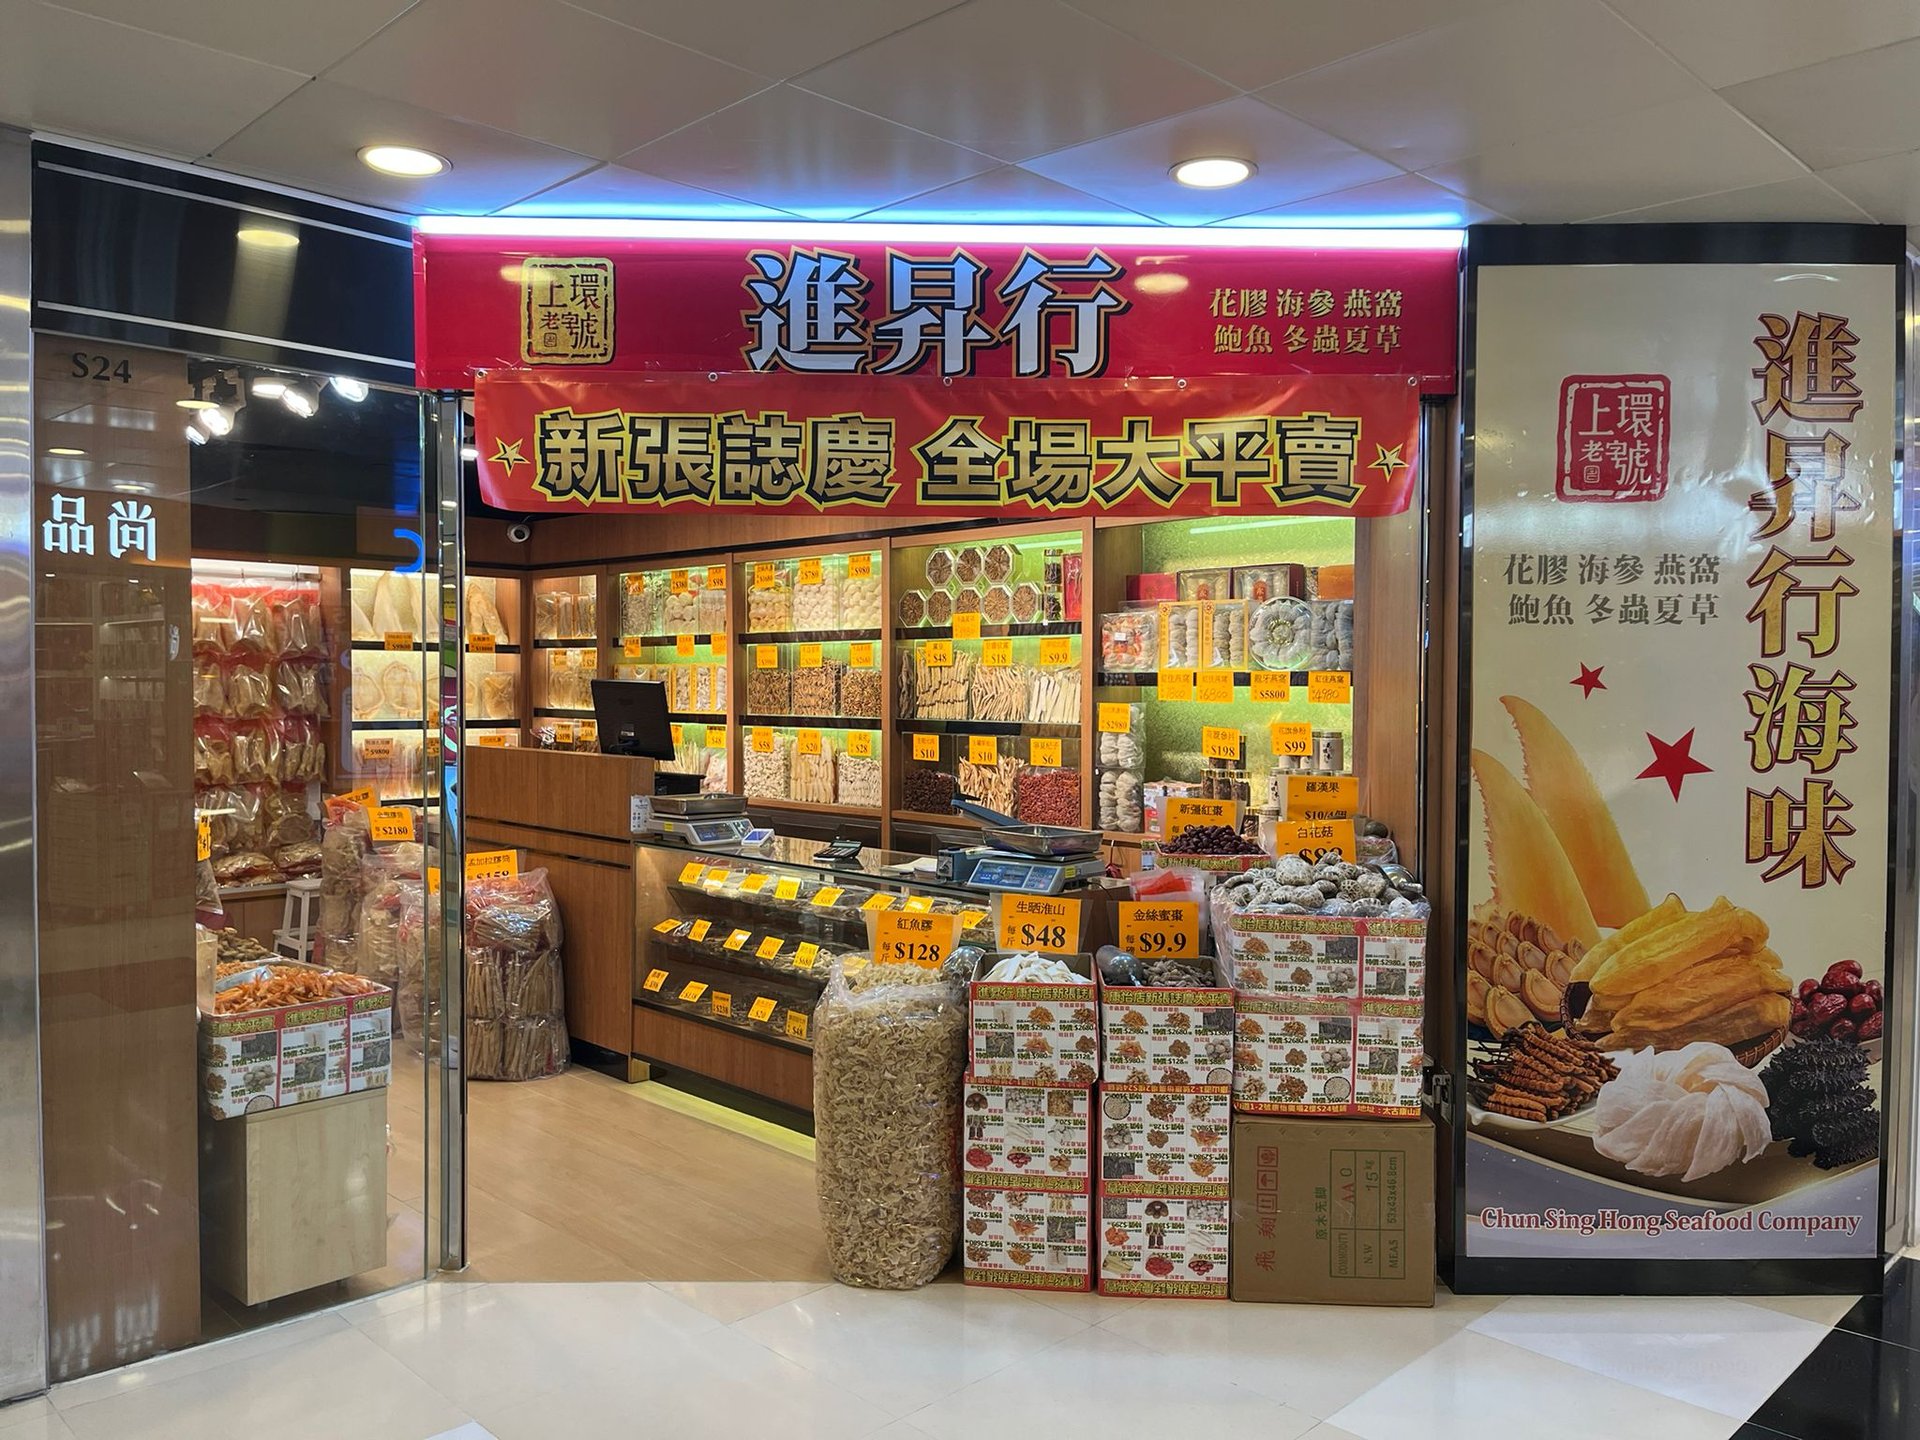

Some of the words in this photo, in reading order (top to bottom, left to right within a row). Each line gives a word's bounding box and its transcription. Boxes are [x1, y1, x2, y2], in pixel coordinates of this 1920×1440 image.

[538, 273, 601, 310] 上環
[743, 247, 1129, 377] 進昇行
[1209, 288, 1267, 319] 花膠
[1277, 288, 1334, 319] 海參
[1343, 289, 1403, 319] 燕窩
[1214, 325, 1273, 354] 鮑魚
[1283, 324, 1402, 355] 冬蟲夏草
[71, 352, 132, 383] S24
[1578, 393, 1654, 438] 上環
[532, 406, 901, 511] 新張誌慶
[910, 412, 1366, 512] 全場大平賣
[1580, 439, 1653, 484] 老字號
[1503, 552, 1568, 586] 花膠
[1578, 552, 1645, 586] 海參
[1654, 552, 1721, 586] 燕窩
[1507, 592, 1574, 626] 鮑魚
[1585, 592, 1720, 626] 冬蟲夏草
[1743, 311, 1864, 889] 進昇行海味
[932, 653, 947, 663] $48
[991, 655, 1007, 664] $18
[1048, 653, 1068, 663] $9.9
[1259, 690, 1285, 699] $5800
[920, 748, 935, 759] $10
[978, 752, 993, 763] $10
[1211, 745, 1235, 757] $198
[1284, 741, 1306, 753] $99
[1042, 754, 1054, 765] $6
[1305, 781, 1340, 793] 羅漢果
[382, 826, 408, 836] $2180
[1297, 825, 1334, 839] 白花菇
[896, 917, 933, 932] 紅魚膠
[1133, 909, 1184, 922] 金絲蜜棗
[1021, 923, 1066, 948] $48
[1139, 932, 1187, 953] $9.9
[894, 942, 940, 962] $128
[1386, 1156, 1399, 1224] 53x43x46.8cm
[1480, 1208, 1540, 1230] Chun
[1544, 1209, 1595, 1236] Sing
[1599, 1209, 1661, 1237] Hong
[1664, 1210, 1752, 1232] Seafood
[1758, 1211, 1863, 1237] Company
[1337, 1232, 1349, 1275] COMMODITY
[1388, 1239, 1399, 1269] MEAS
